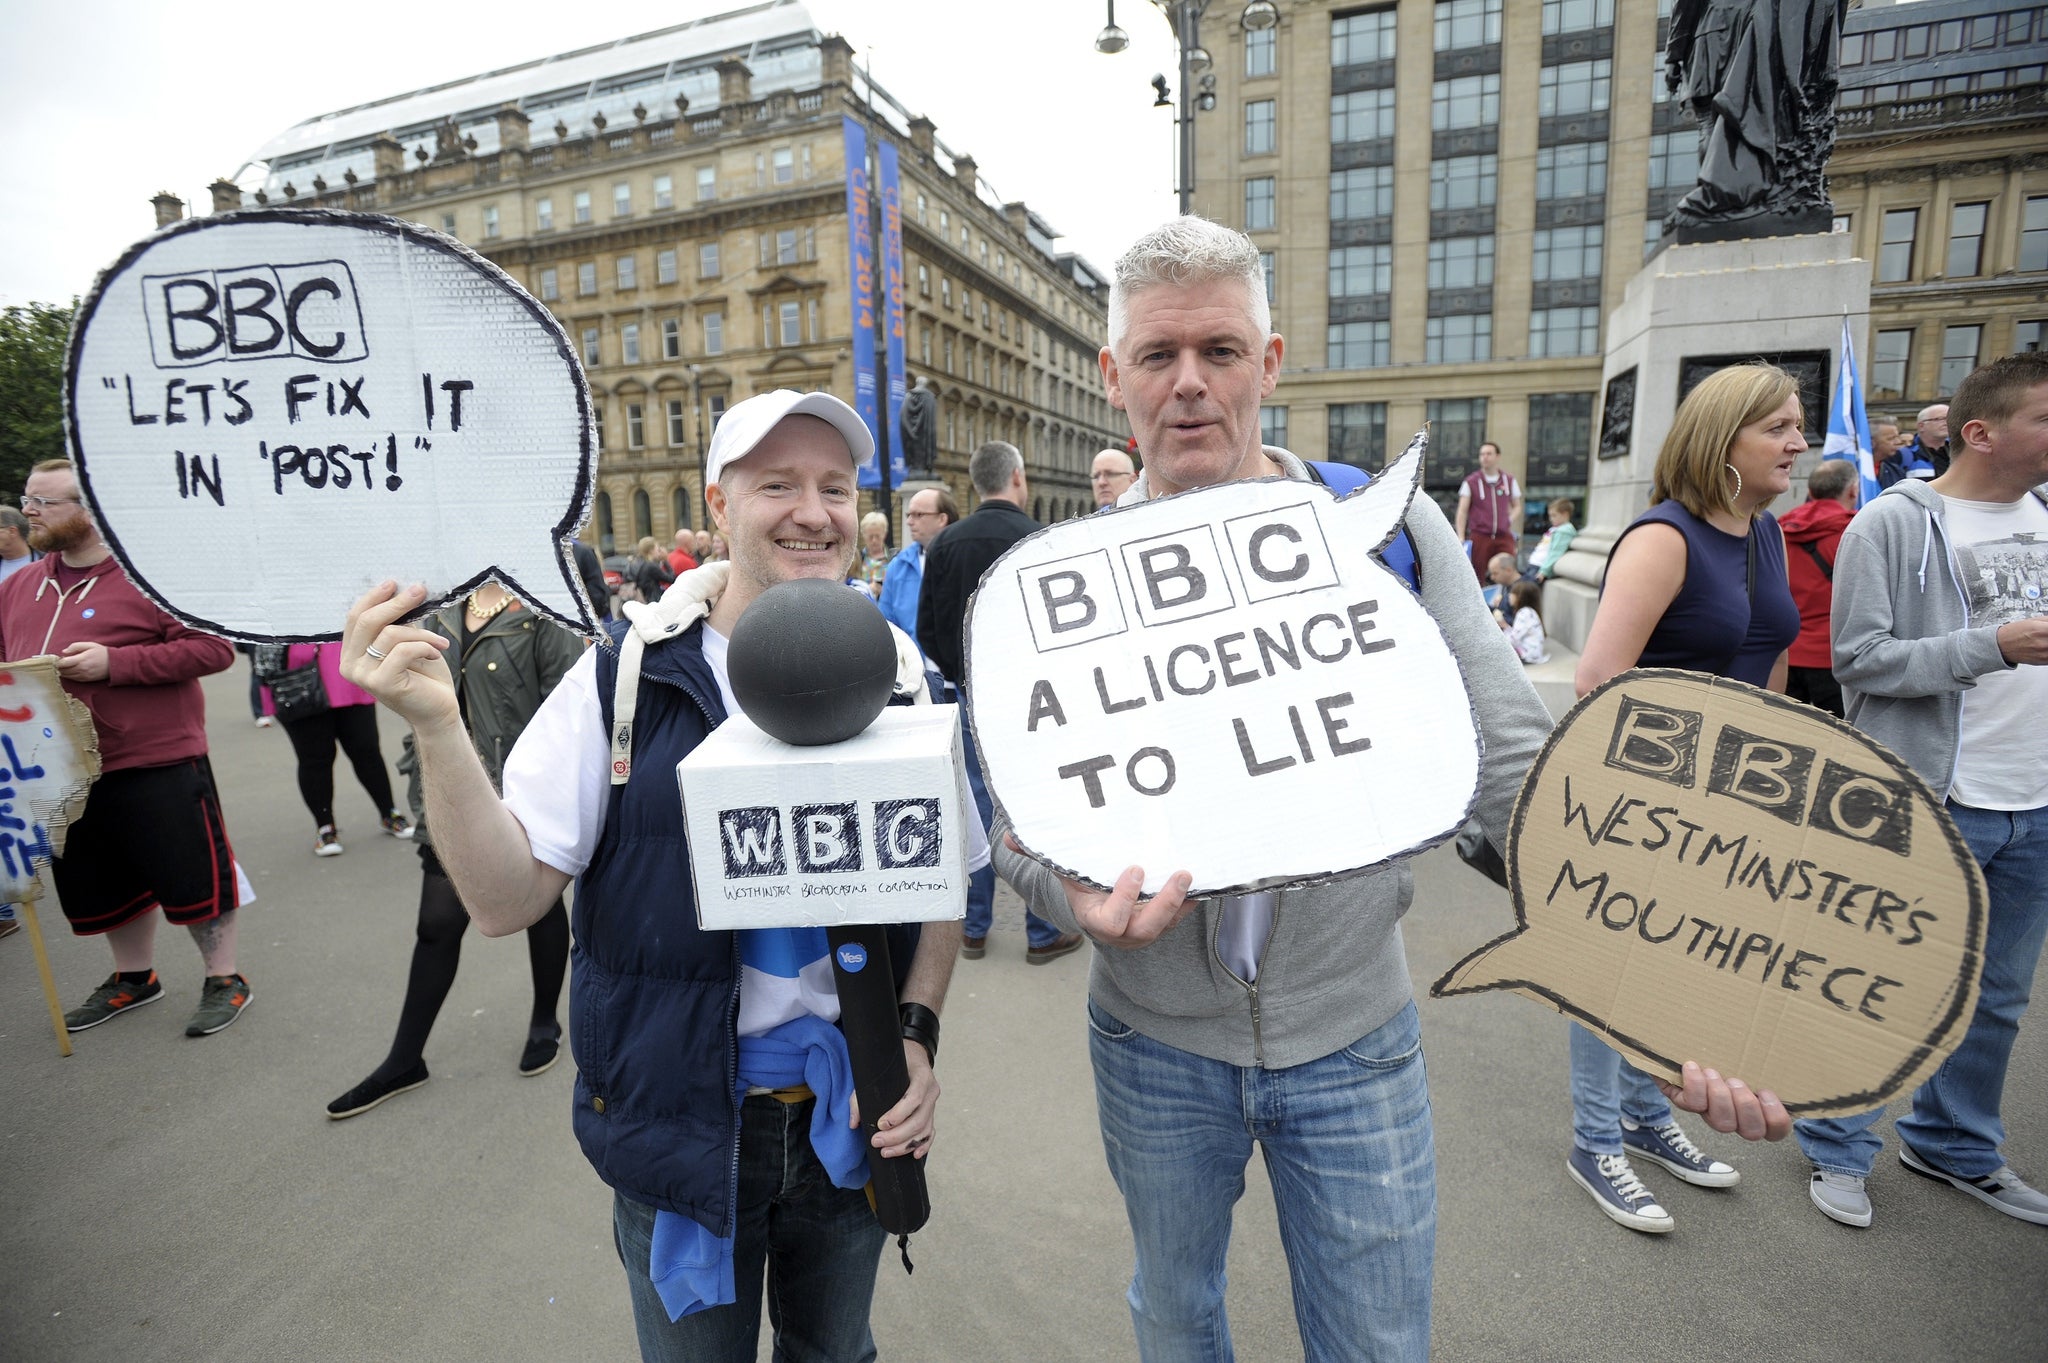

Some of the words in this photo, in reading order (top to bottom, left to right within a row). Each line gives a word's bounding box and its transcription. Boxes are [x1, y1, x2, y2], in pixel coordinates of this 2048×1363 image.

[162, 277, 346, 359] BBC
[857, 252, 874, 328] 2014
[285, 374, 369, 424] FIX
[423, 373, 473, 431] IT
[175, 450, 225, 506] IN
[1039, 523, 1310, 633] BBC
[1027, 679, 1067, 732] A
[1094, 600, 1395, 714] LICENCE
[1058, 746, 1176, 808] TO
[1232, 692, 1371, 777] LIE
[1612, 705, 1897, 842] BBC
[722, 803, 928, 867] WBC
[801, 883, 867, 898] BROADCASTING
[878, 879, 948, 893] CORPORATION
[839, 951, 863, 963] Yes
[1547, 859, 1904, 1021] MOUTHPIECE
